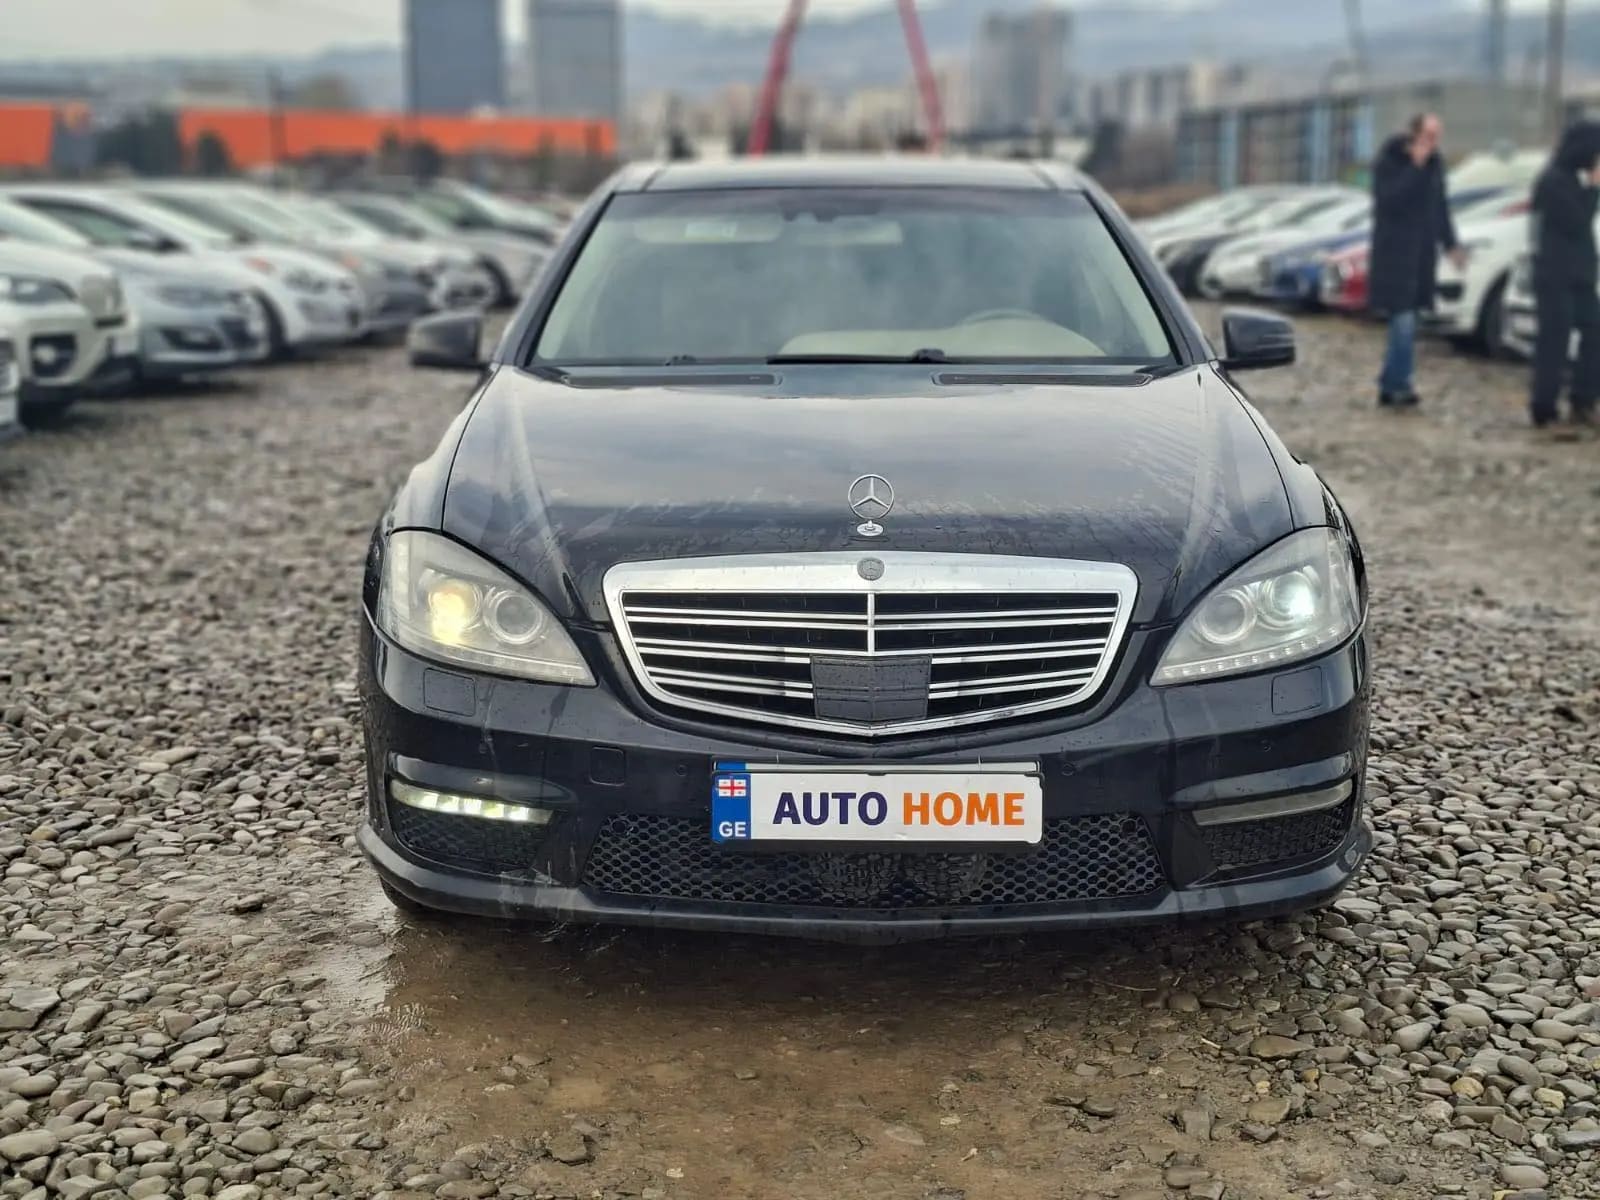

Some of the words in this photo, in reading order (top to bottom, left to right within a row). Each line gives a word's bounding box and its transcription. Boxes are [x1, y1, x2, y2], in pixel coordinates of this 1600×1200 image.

[773, 791, 888, 826] AUTO
[902, 792, 1025, 826] HOME
[718, 820, 747, 838] GE
